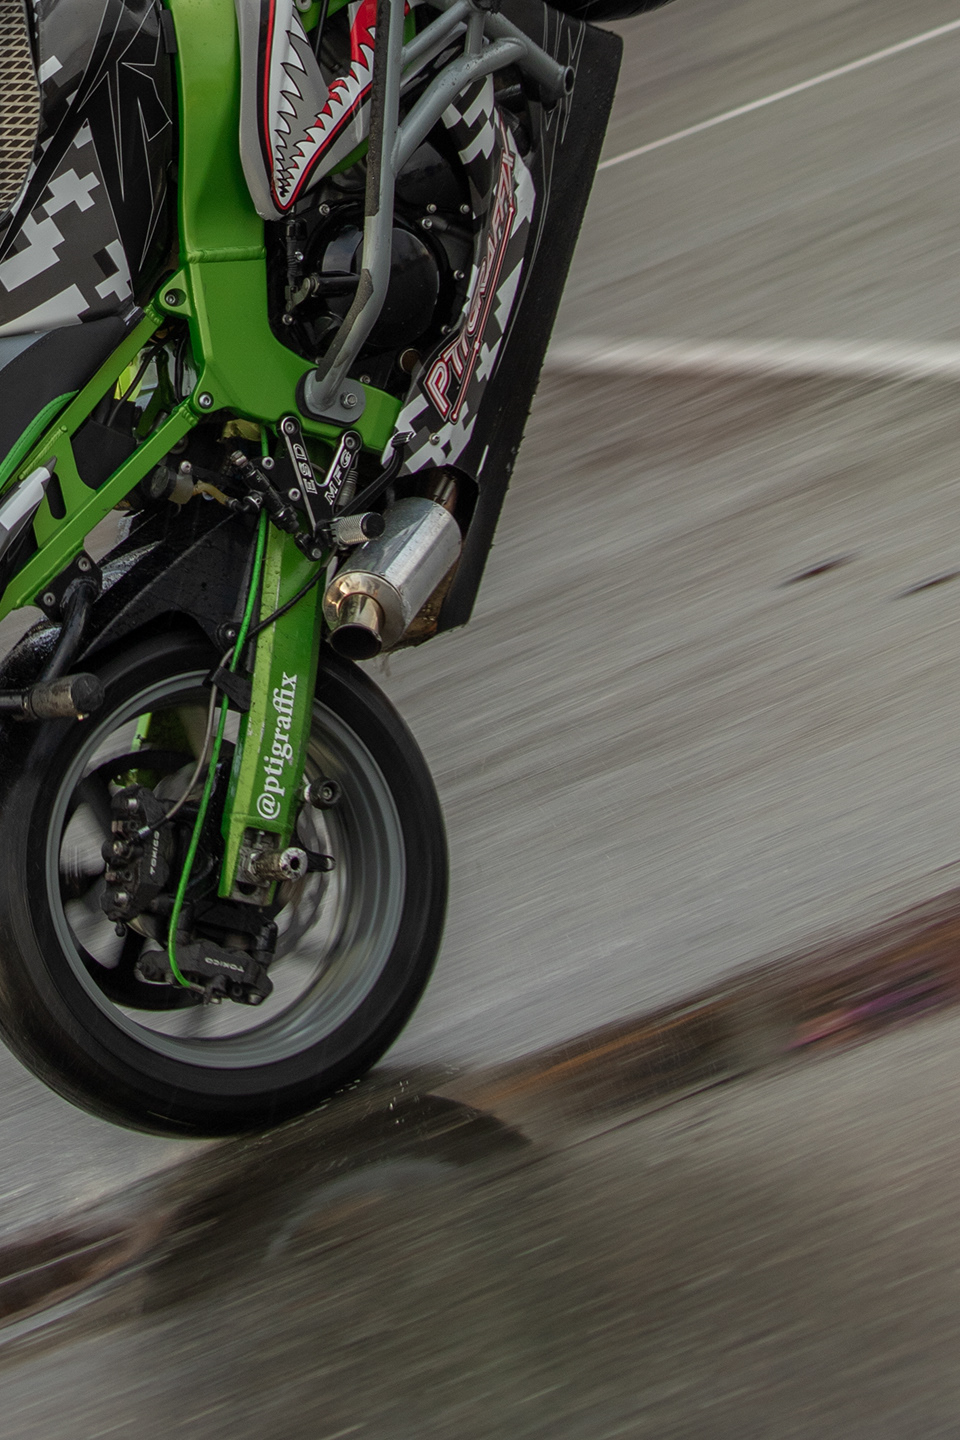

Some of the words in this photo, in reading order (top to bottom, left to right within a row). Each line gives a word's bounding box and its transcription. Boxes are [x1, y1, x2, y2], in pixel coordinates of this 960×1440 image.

[293, 443, 318, 495] ESD
[324, 449, 352, 506] MFG
[257, 671, 298, 820] @ptigraffix
